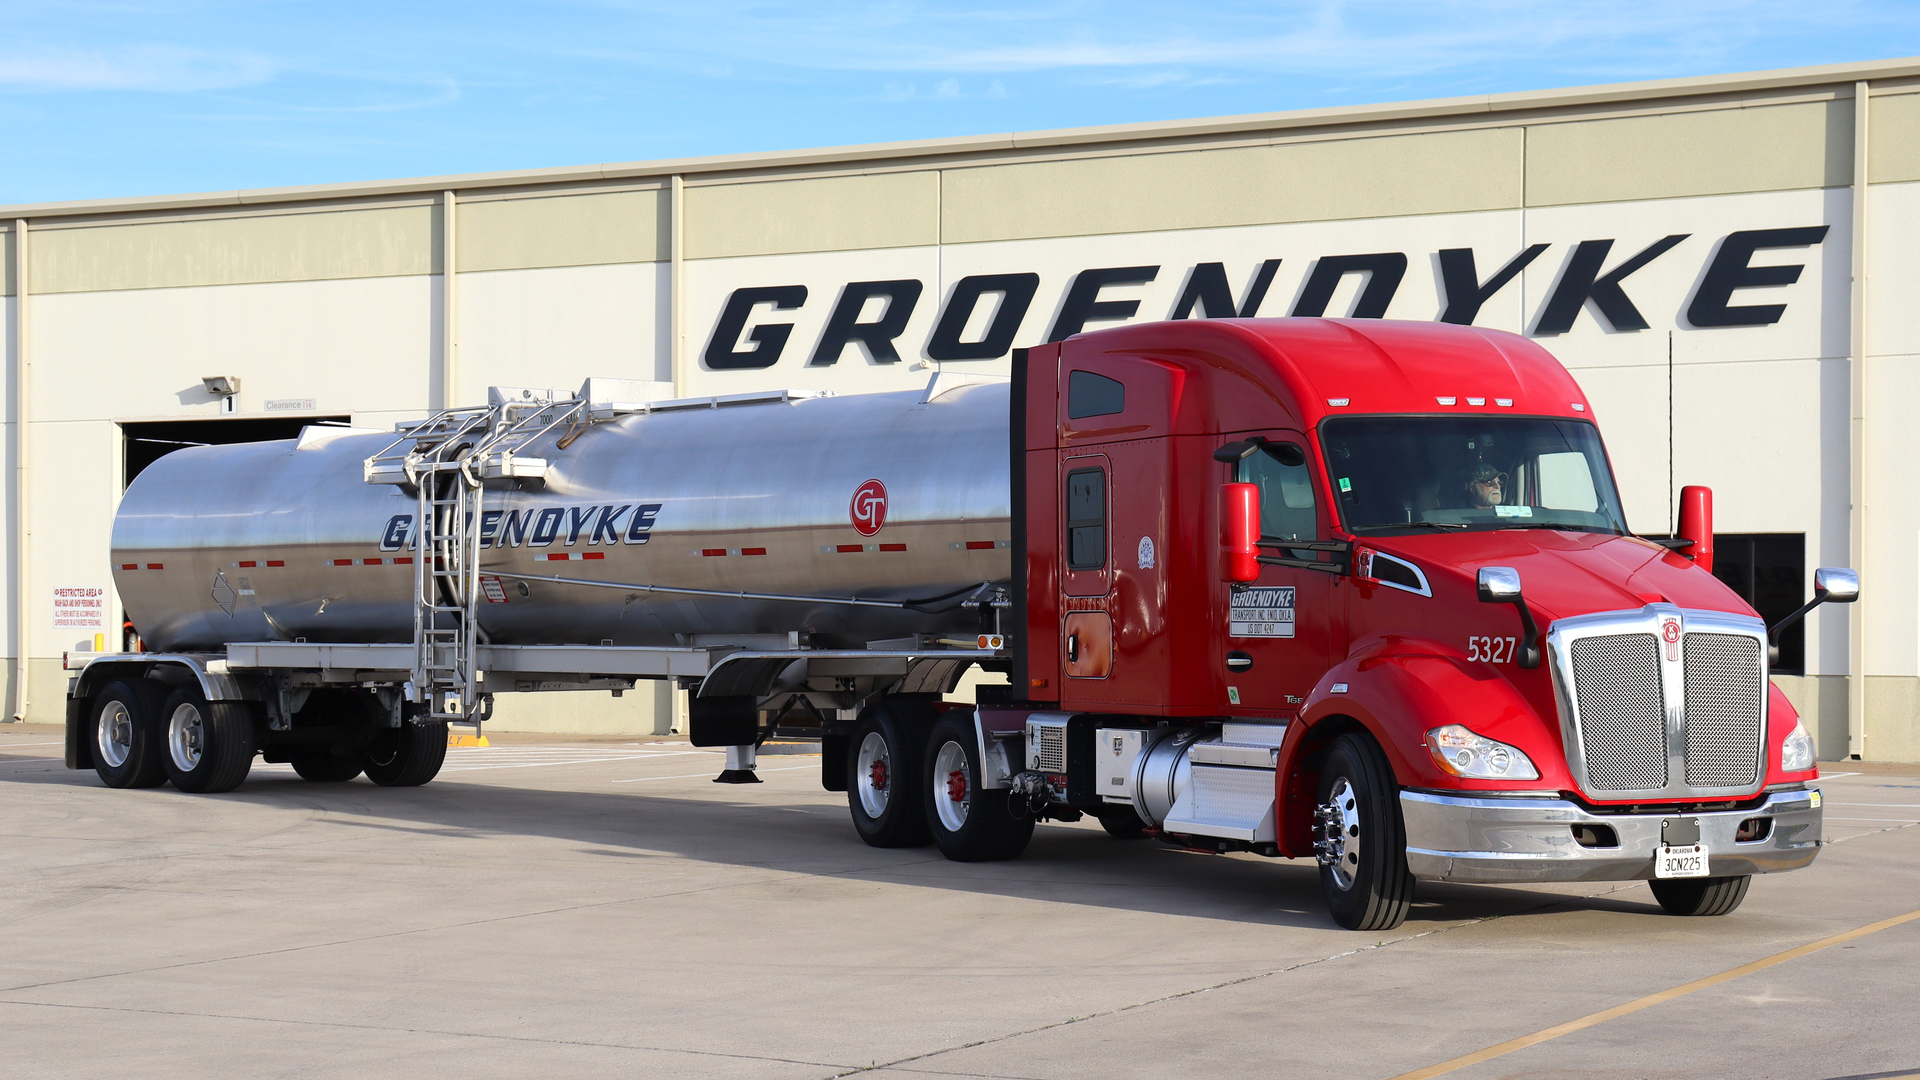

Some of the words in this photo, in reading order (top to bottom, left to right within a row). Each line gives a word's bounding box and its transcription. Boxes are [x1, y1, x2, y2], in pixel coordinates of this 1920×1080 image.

[705, 225, 1830, 369] GROENDYKE
[226, 396, 232, 412] 1
[266, 401, 301, 410] Clearance
[854, 488, 885, 528] GT
[379, 503, 663, 552] GENDYKE
[60, 588, 85, 597] RESTRICTED
[86, 588, 97, 597] AREA
[1231, 590, 1294, 607] GROENDYKE
[1247, 623, 1253, 634] US
[1254, 623, 1263, 634] DOT
[1264, 623, 1275, 634] 4247
[1467, 636, 1516, 664] 5327
[1665, 856, 1701, 872] 3CN225
